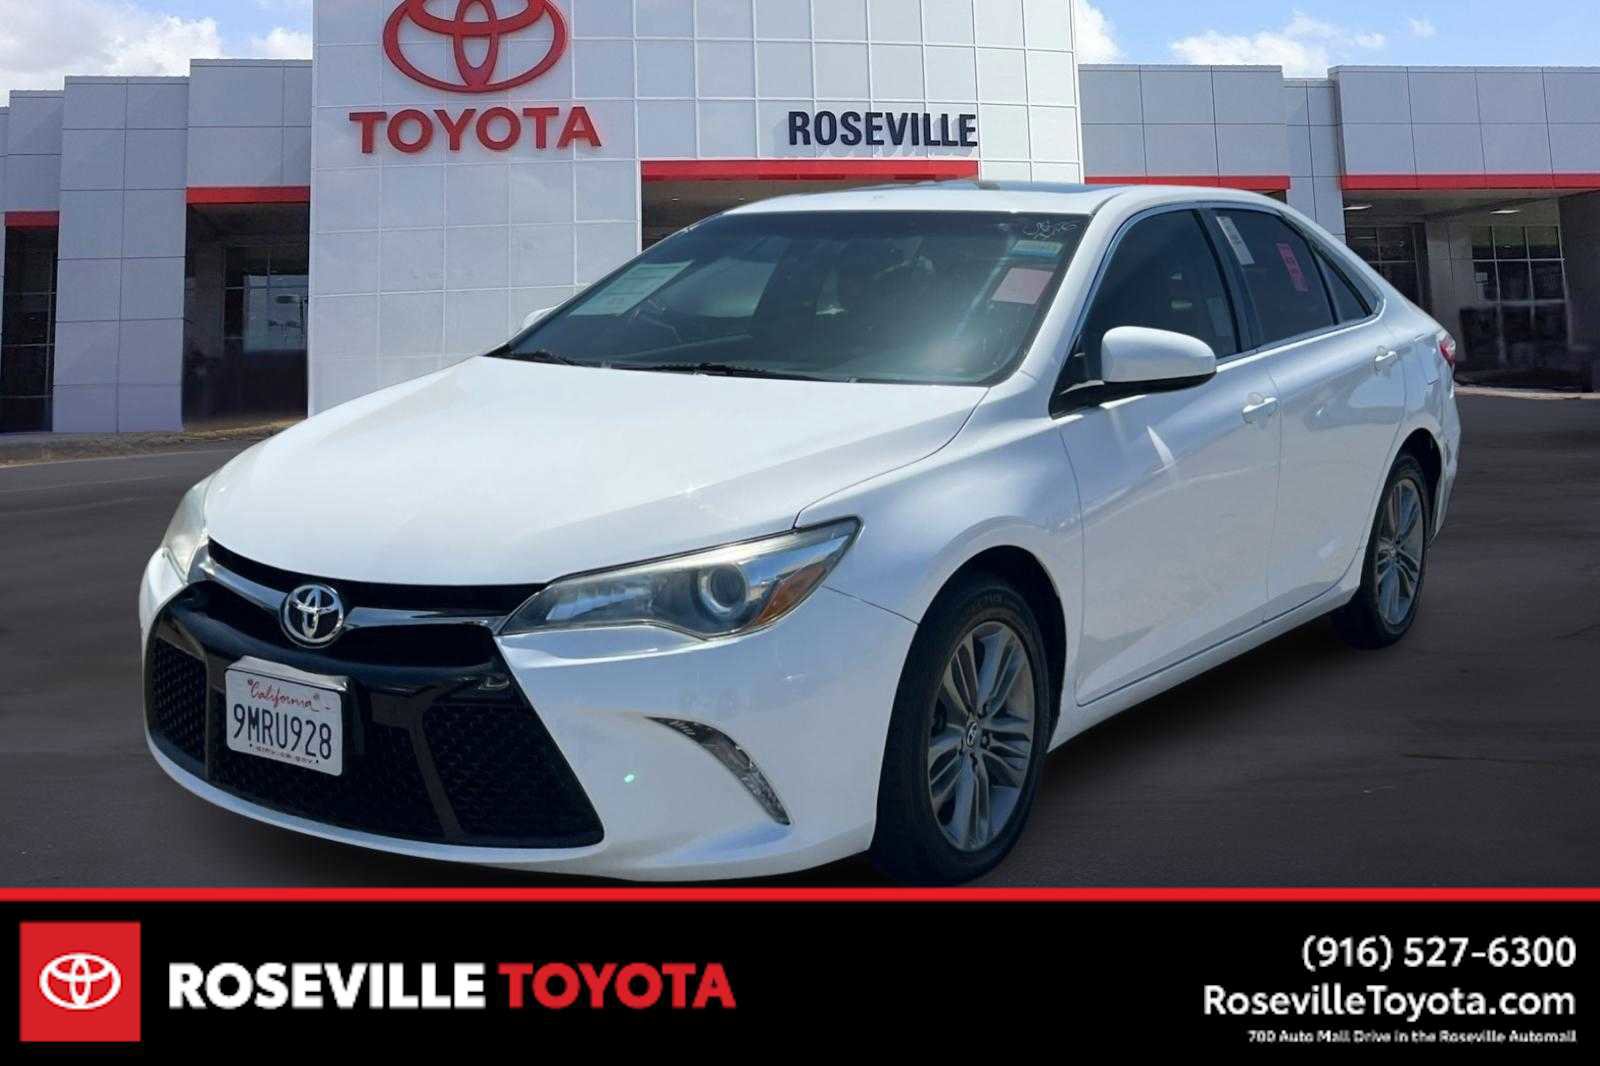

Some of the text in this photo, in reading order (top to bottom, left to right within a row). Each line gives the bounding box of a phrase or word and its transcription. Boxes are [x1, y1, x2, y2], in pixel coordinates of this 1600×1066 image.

[349, 106, 602, 154] TOYOTA
[788, 110, 978, 147] ROSEVILLE
[249, 679, 320, 712] California
[233, 703, 332, 760] 9MRU928
